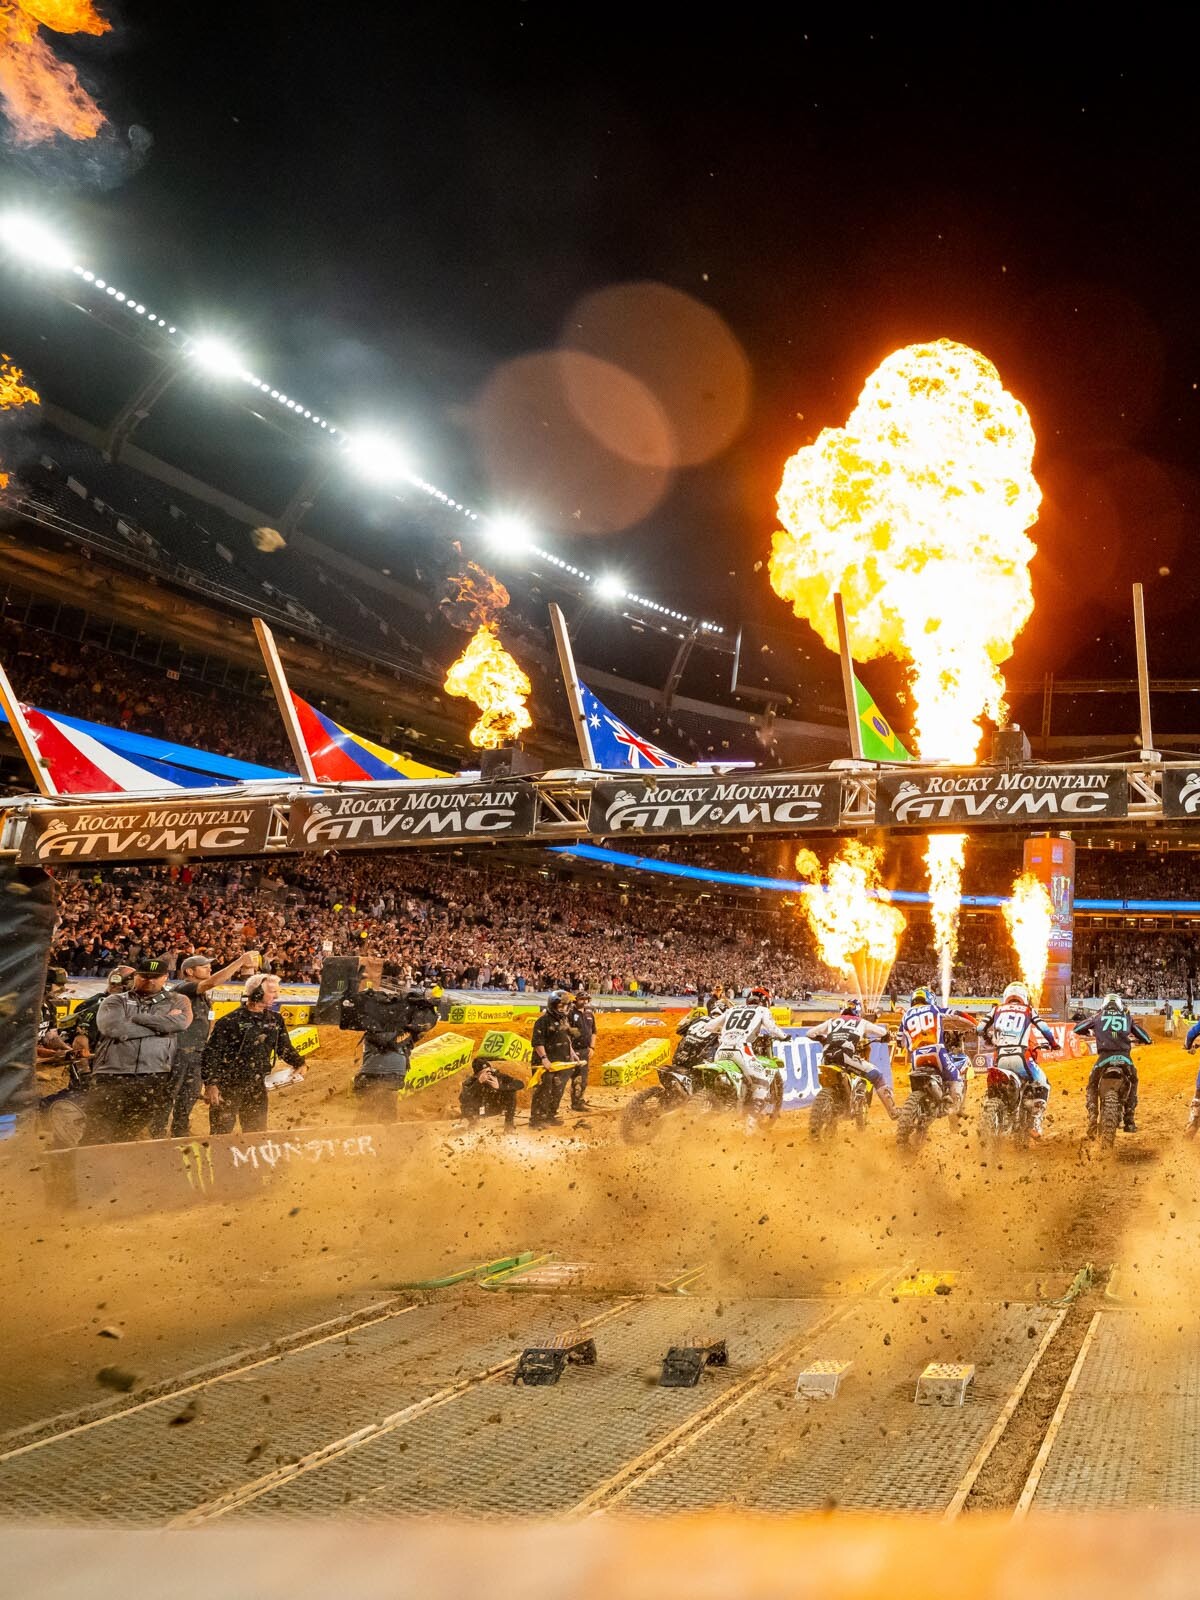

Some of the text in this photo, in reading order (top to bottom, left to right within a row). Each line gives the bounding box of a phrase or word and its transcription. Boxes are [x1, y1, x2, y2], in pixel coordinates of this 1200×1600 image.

[711, 783, 824, 800] MOUNTAIN
[925, 773, 1111, 793] ROCKY MOUNTAIN
[335, 797, 402, 815] ROCKY
[71, 810, 255, 831] ROCKY MOUNTAIN
[725, 1010, 756, 1030] 68
[906, 1012, 934, 1037] 90
[994, 1011, 1026, 1032] 460
[1101, 1016, 1128, 1032] 751
